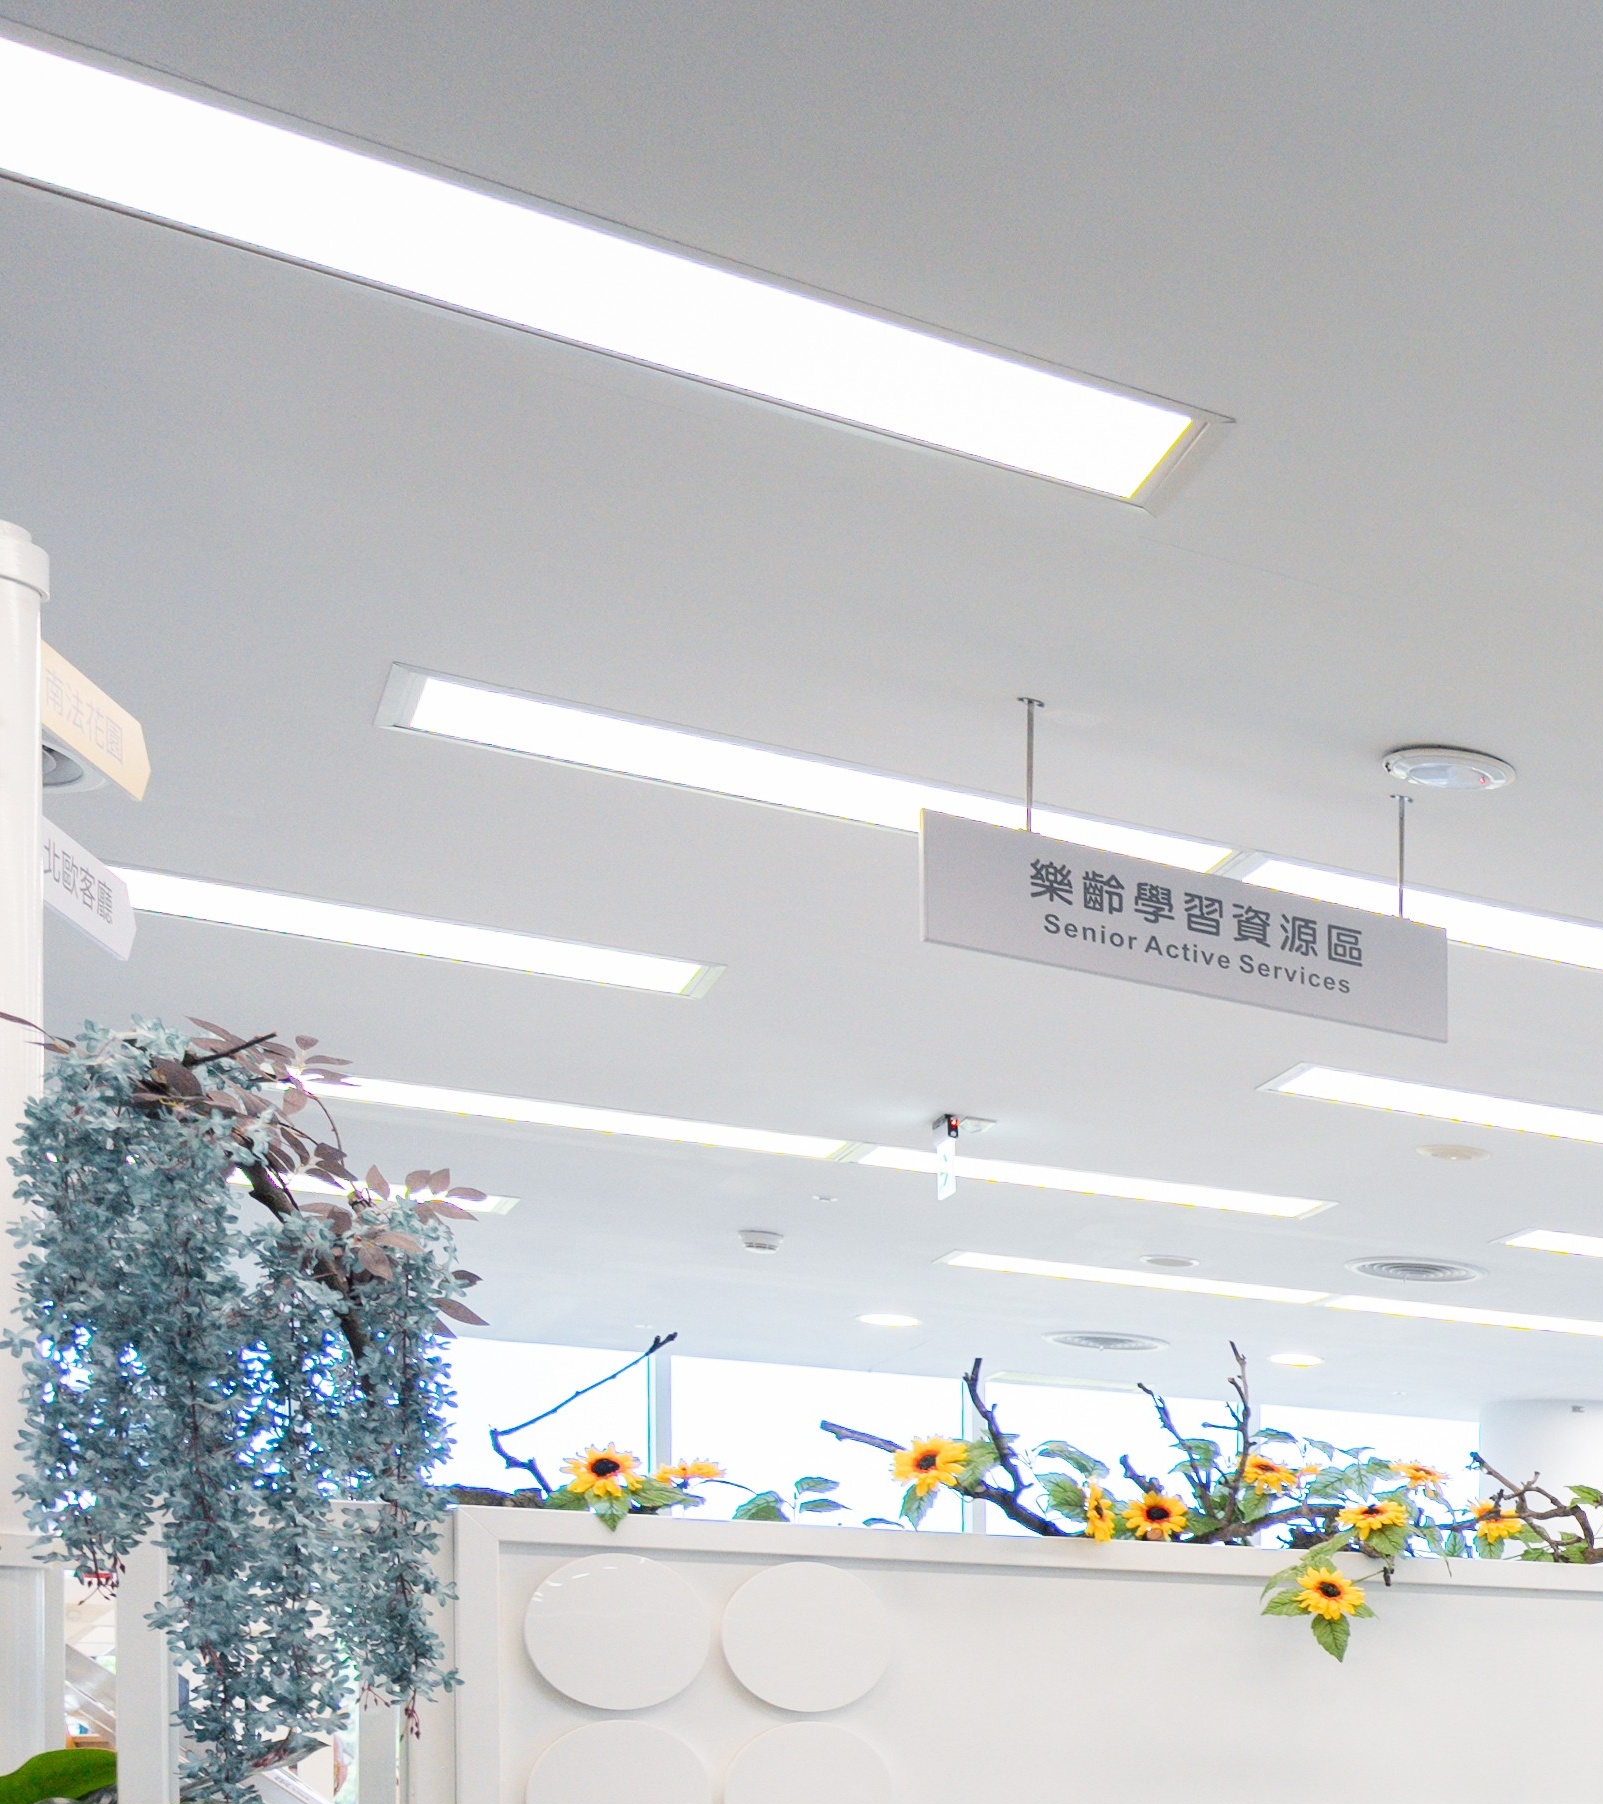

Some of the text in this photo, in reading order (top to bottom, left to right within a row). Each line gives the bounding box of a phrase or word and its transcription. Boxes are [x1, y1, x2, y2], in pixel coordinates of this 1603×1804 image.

[45, 669, 124, 764] 南法花園
[43, 838, 113, 925] 北歐客廳
[1030, 858, 1363, 967] 樂齡學習資源區
[1043, 912, 1352, 995] Senior Active Services
